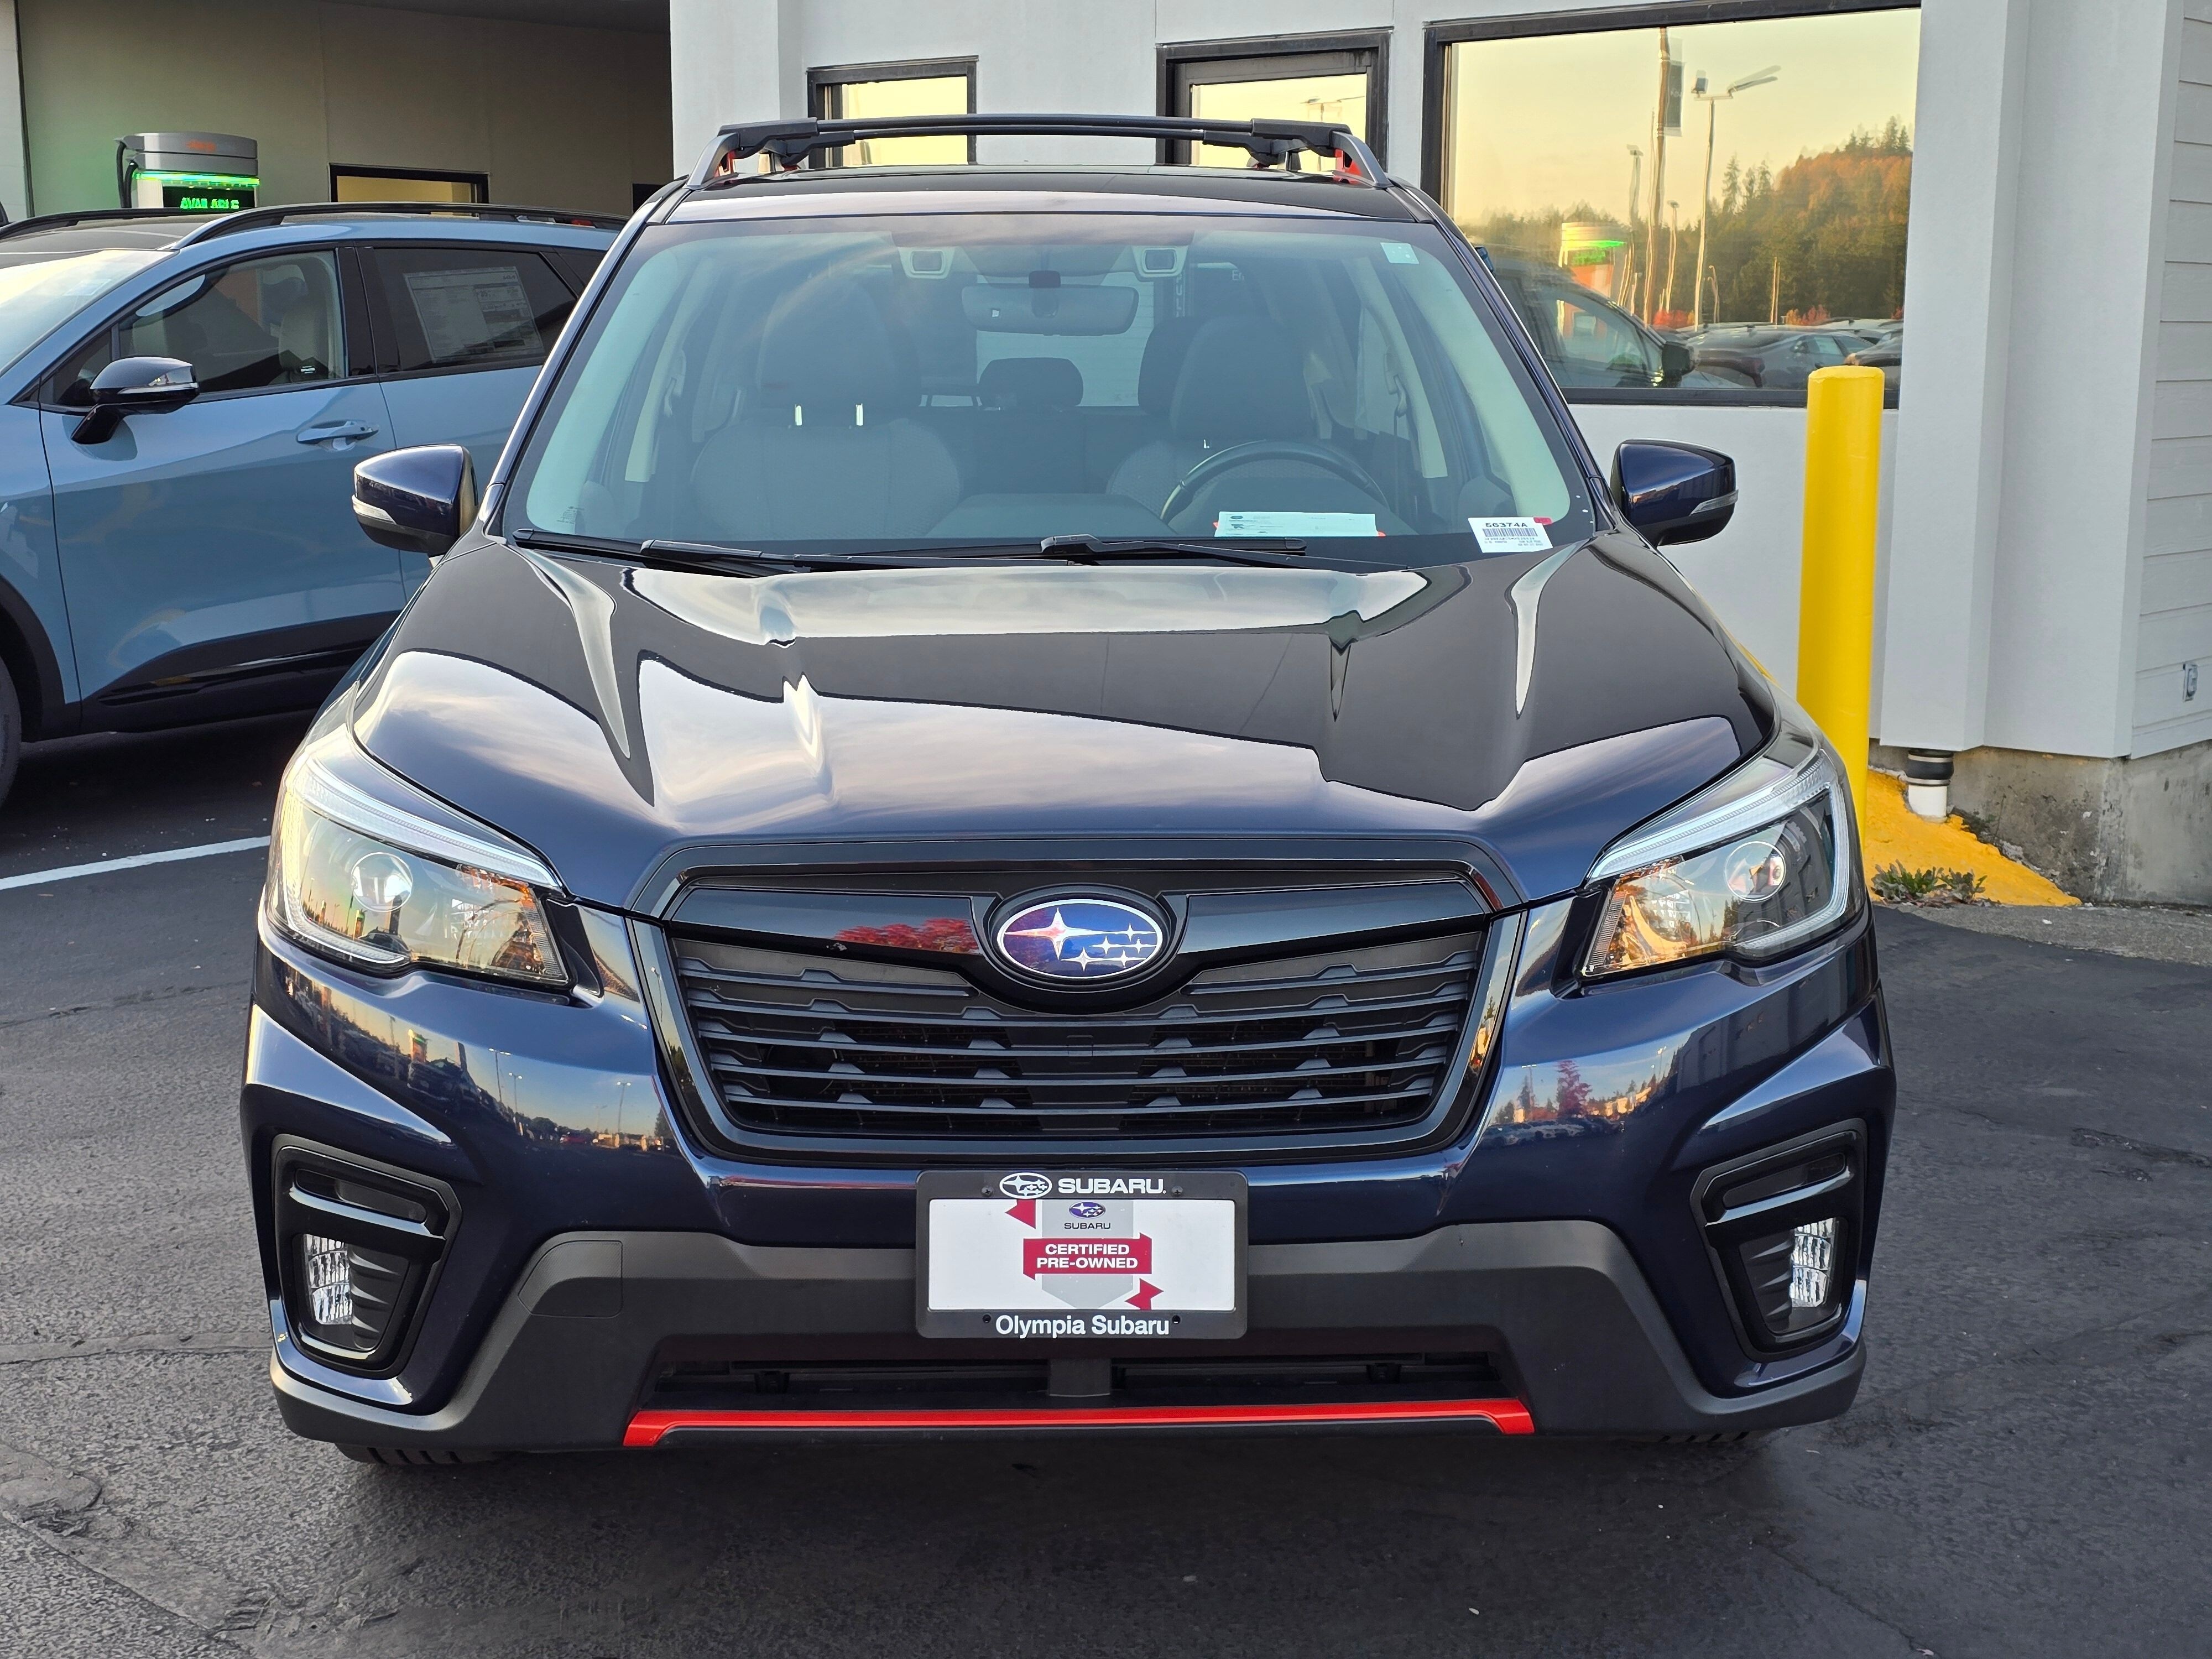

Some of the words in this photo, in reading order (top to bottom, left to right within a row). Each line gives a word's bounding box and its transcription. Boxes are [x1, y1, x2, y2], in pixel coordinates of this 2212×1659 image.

[1058, 1178, 1164, 1194] SUBARU
[1045, 1244, 1130, 1255] CERTIFIED
[1036, 1258, 1138, 1269] PRE-OWNED
[996, 1314, 1086, 1339] Olympia
[1092, 1315, 1169, 1334] Subaru
